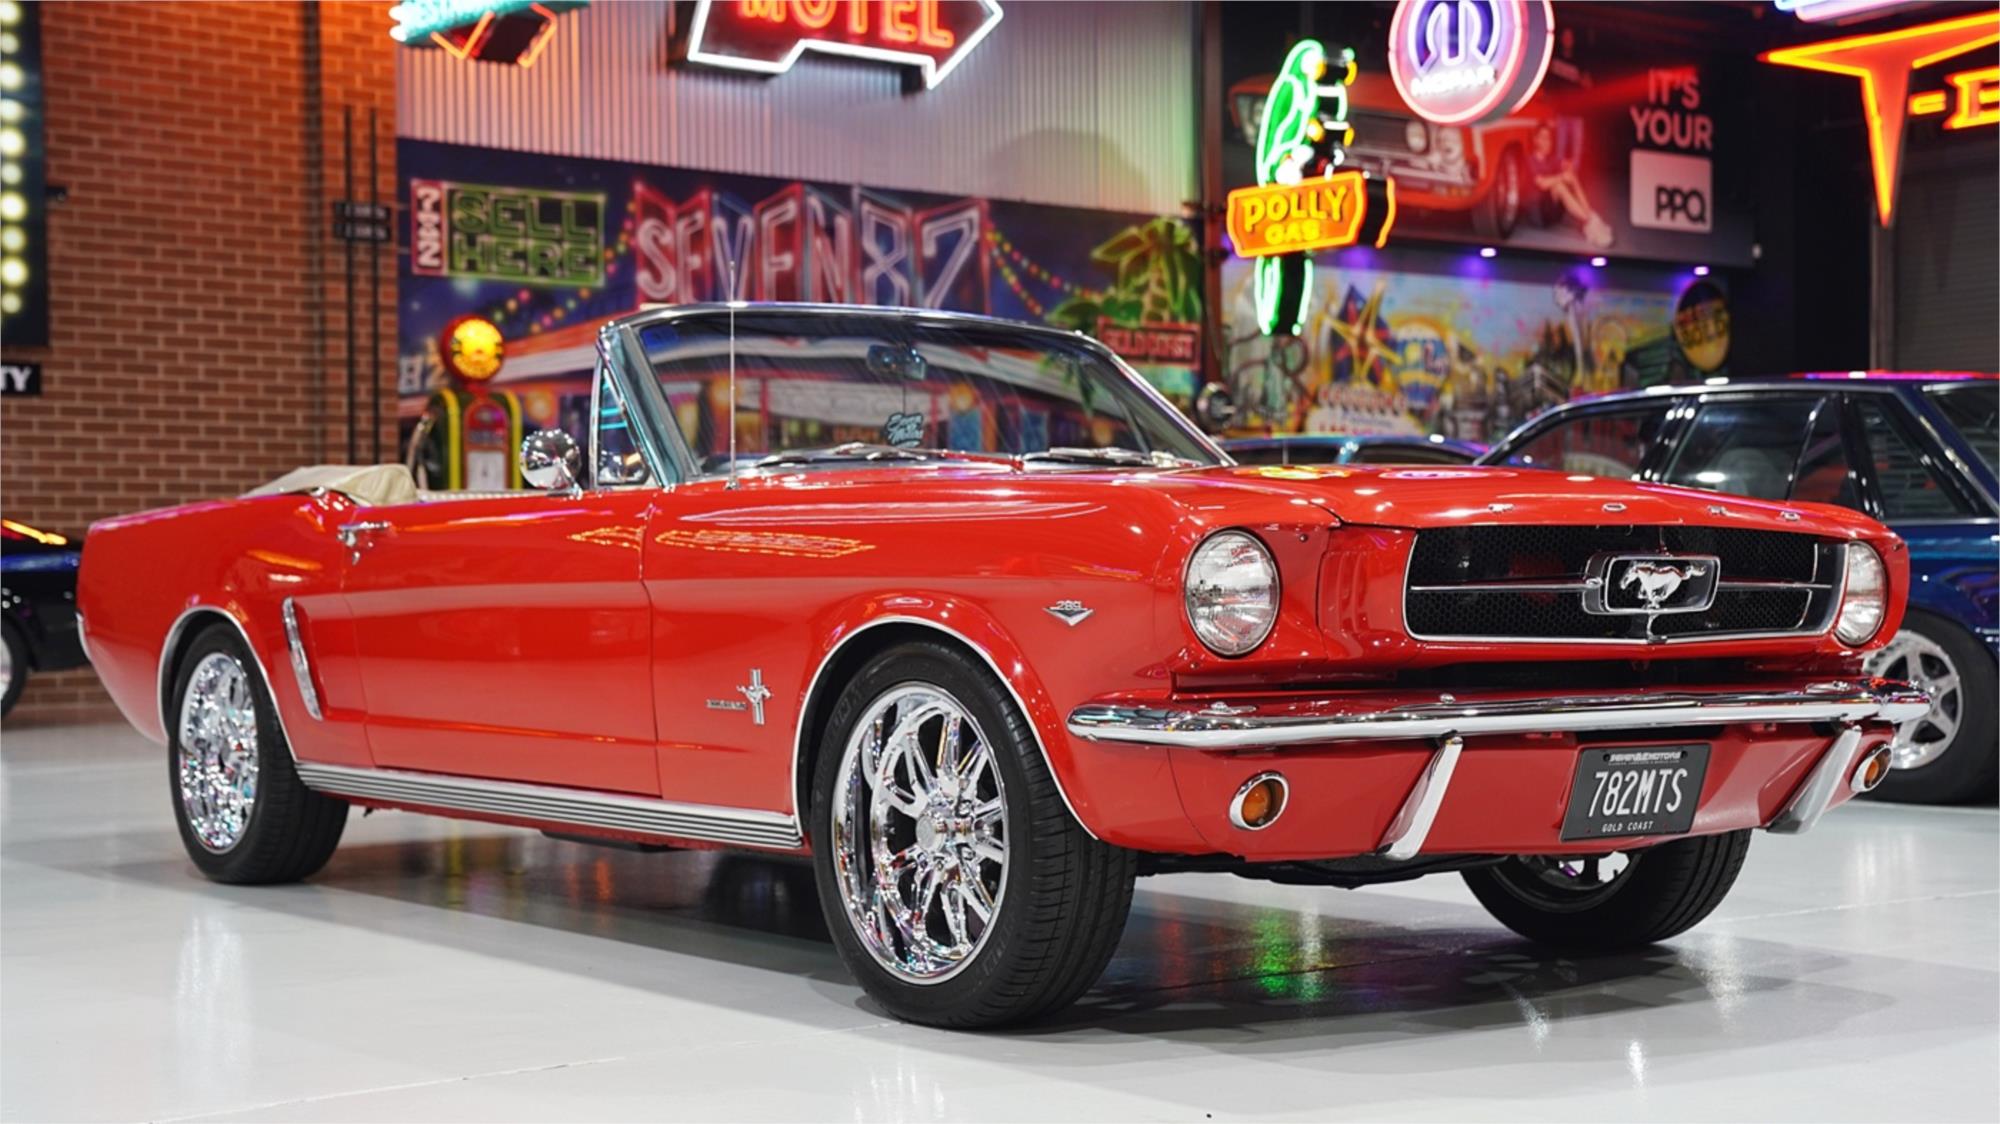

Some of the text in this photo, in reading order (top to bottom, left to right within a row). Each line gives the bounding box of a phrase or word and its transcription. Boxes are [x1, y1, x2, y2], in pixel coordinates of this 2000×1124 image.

[1410, 64, 1497, 97] MOPAR
[1647, 69, 1701, 109] IT'S
[1629, 106, 1713, 149] YOUR
[453, 189, 598, 242] SELL
[1241, 185, 1348, 232] POLLY
[1655, 185, 1706, 223] PPQ
[1265, 219, 1321, 245] GAS
[453, 232, 598, 279] HERE
[1588, 767, 1689, 818] 782MTS
[1602, 820, 1654, 833] GOLD COAST
